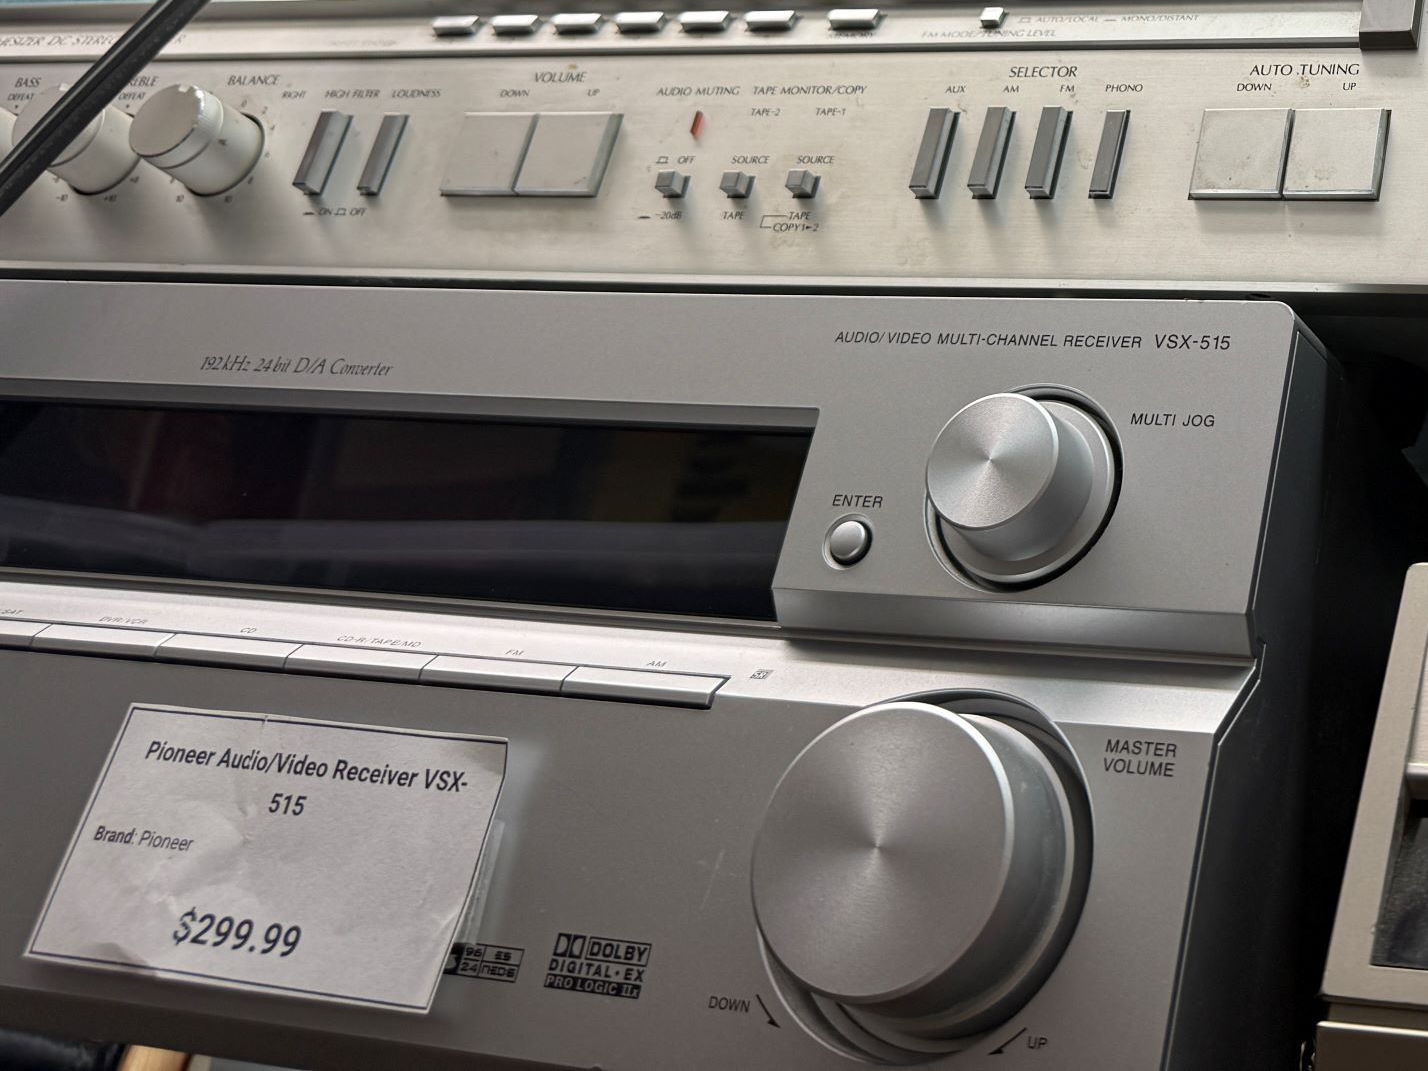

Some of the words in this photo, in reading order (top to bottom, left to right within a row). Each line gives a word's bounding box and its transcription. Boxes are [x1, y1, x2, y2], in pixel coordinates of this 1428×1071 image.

[1120, 12, 1200, 24] MONO/DISTANT
[1008, 64, 1079, 79] SELECTOR
[1249, 62, 1294, 77] AUTO
[1300, 61, 1362, 77] TUNING
[14, 76, 42, 89] BASS
[227, 74, 281, 86] BALANCE
[534, 71, 587, 84] VOLUME
[500, 88, 530, 98] DOWN
[656, 85, 693, 97] AUDIO
[695, 85, 741, 97] MUTING
[752, 84, 778, 96] TAPE
[779, 84, 868, 96] MONITOR/COPY
[945, 84, 967, 95] AUX
[1002, 83, 1021, 94] AM
[1059, 83, 1076, 94] FM
[1105, 83, 1144, 94] PHONO
[1236, 82, 1273, 93] DOWN
[1342, 81, 1357, 92] UP
[324, 89, 350, 99] HIGH
[351, 88, 381, 99] FILTER
[391, 89, 442, 99] LOUDNESS
[677, 155, 696, 165] OFF
[730, 155, 771, 165] SOURCE
[796, 155, 836, 165] SOURCE
[722, 211, 745, 221] TAPE
[788, 211, 813, 221] TAPE
[835, 331, 932, 346] AUDIO/VIDEO
[937, 332, 1058, 348] MULTI-CHANNEL
[1063, 333, 1143, 349] RECEIVER
[1154, 333, 1232, 351] VSX-515
[200, 355, 251, 373] 192kHz
[294, 356, 327, 375] D/A
[330, 358, 394, 377] Converter
[1130, 413, 1176, 427] MULTI
[1182, 413, 1216, 428] JOG
[832, 494, 884, 509] ENTER
[1105, 739, 1178, 760] MASTER
[145, 740, 216, 768] Pioneer
[217, 747, 329, 780] Audio/Video
[333, 759, 420, 788] Receiver
[424, 769, 469, 794] VSX-
[1103, 757, 1176, 778] VOLUME
[268, 792, 307, 818] 515
[93, 825, 138, 847] Brand:
[138, 830, 195, 853] Pioneer
[173, 906, 302, 959] $299.99
[589, 940, 649, 963] DOLBY
[548, 957, 612, 979] DIGITAL
[623, 968, 645, 983] EX
[546, 975, 573, 989] PRO
[576, 978, 618, 995] LOGIC
[708, 995, 750, 1014] DOWN
[1027, 1035, 1048, 1051] UP
